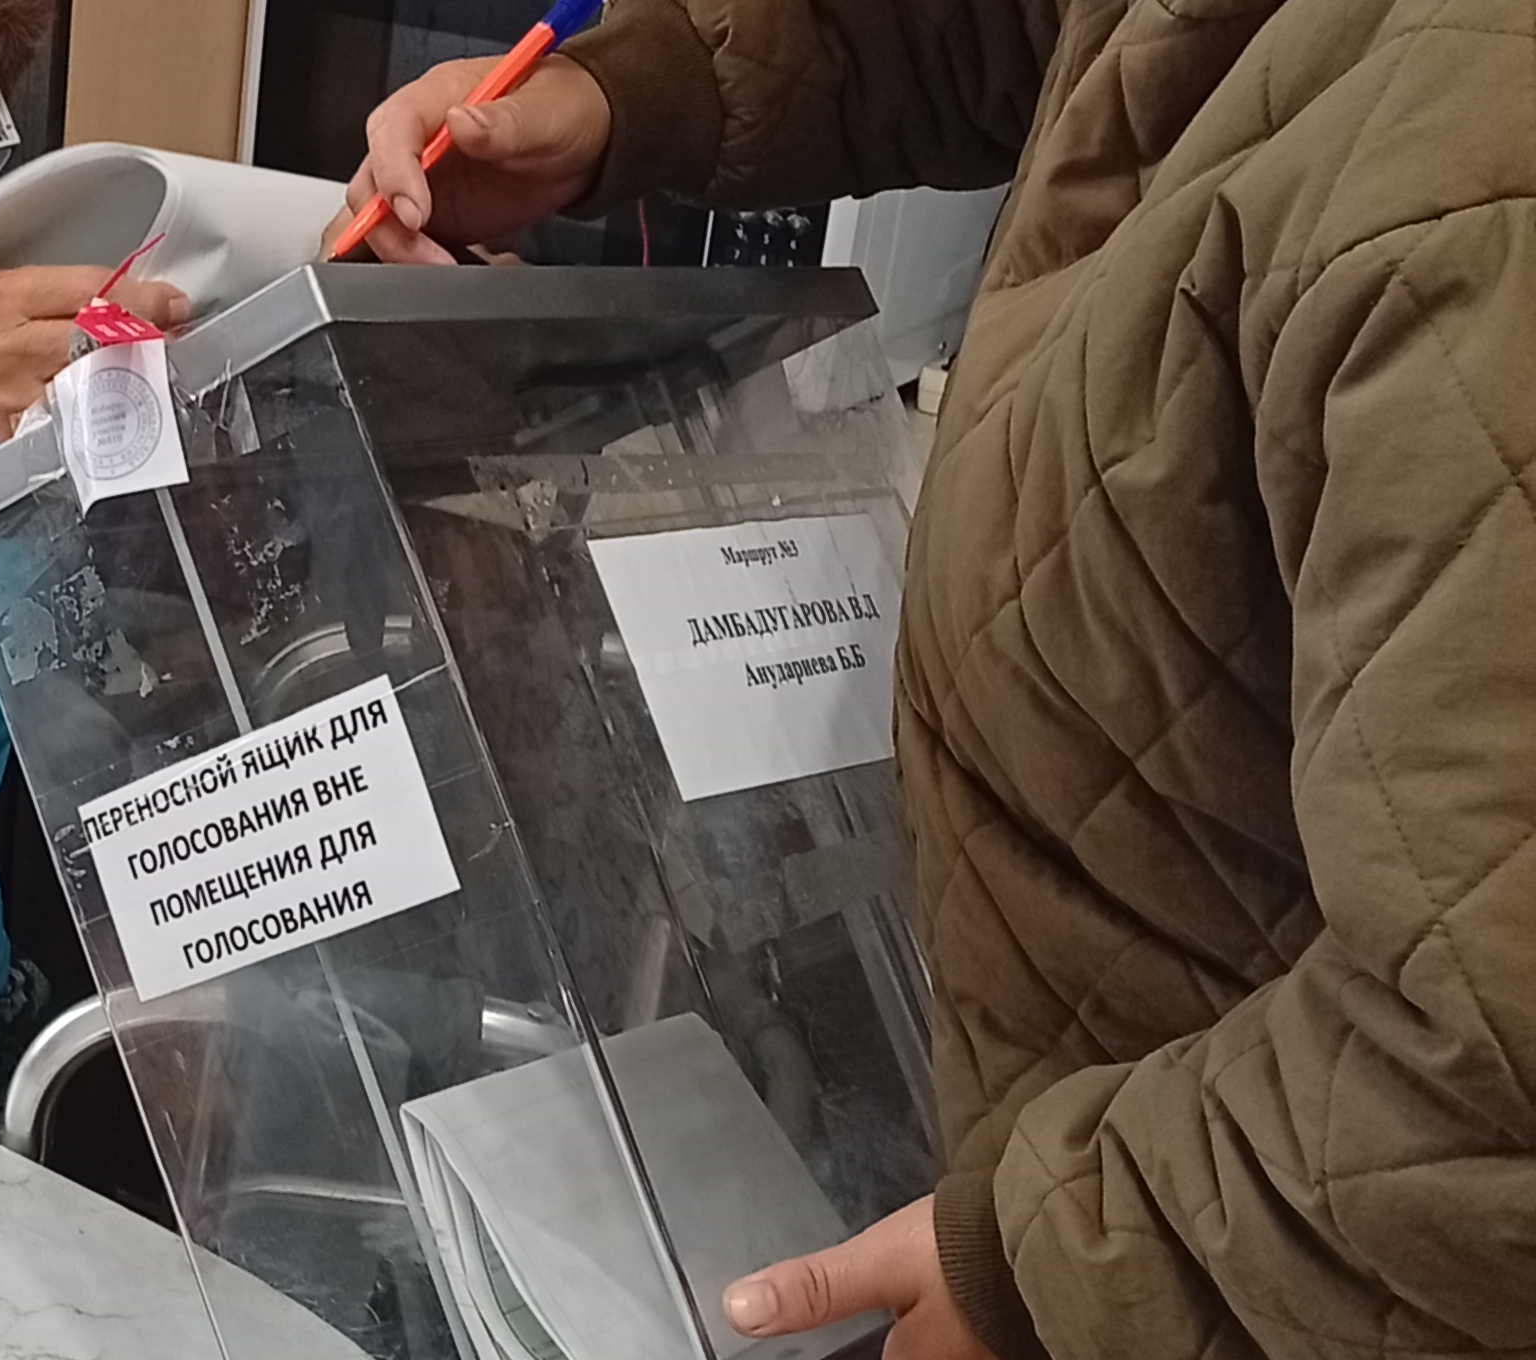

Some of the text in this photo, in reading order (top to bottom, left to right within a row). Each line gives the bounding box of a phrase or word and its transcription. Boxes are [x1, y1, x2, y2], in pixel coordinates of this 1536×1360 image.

[720, 543, 778, 567] Маршрут
[686, 597, 849, 647] ДАМБАДУГАРОВА
[83, 699, 389, 843] ПЕРЕНОСНОЙ ЯЩИК ДЛЯ
[127, 765, 368, 879] ГОЛОСОВАНИЯ ВНЕ
[149, 820, 376, 926] ПОМЕЩЕНИЯ ДЛЯ
[182, 880, 372, 969] ГОЛОСОВАНИЯ
